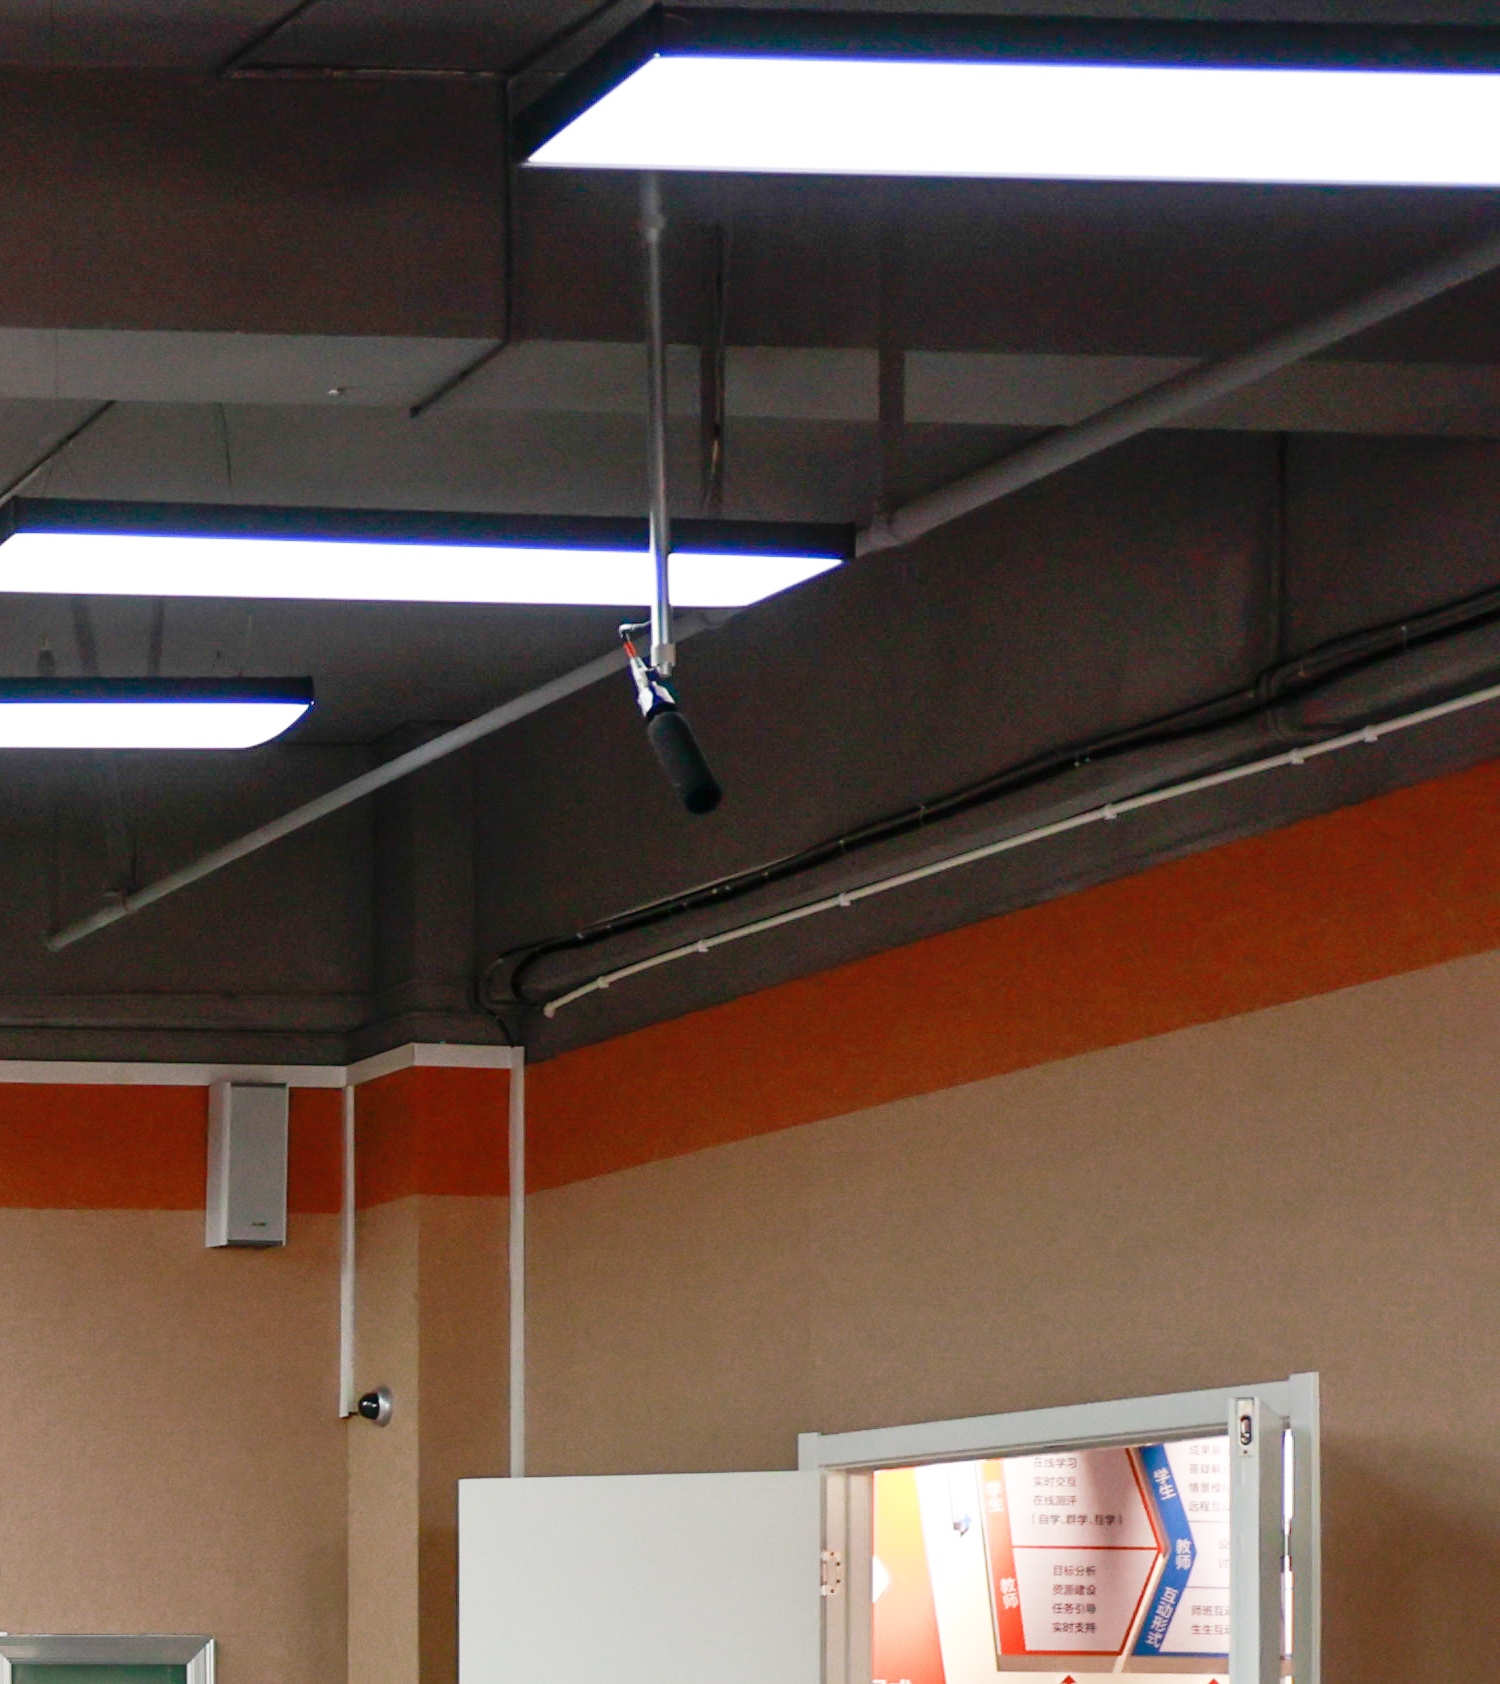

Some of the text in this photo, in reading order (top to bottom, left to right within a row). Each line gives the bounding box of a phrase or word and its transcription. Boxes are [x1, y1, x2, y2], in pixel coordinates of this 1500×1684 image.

[1034, 1457, 1077, 1468] 在线学习
[1033, 1476, 1076, 1487] 实时交互
[1153, 1466, 1177, 1501] 学生
[1034, 1495, 1077, 1506] 在线测评
[1175, 1538, 1192, 1571] 教师
[1053, 1565, 1097, 1577] 目标分析
[1000, 1576, 1019, 1609] 教师
[1052, 1584, 1097, 1595] 资源建设
[1052, 1603, 1097, 1615] 任务引导
[1052, 1622, 1097, 1634] 实时支持
